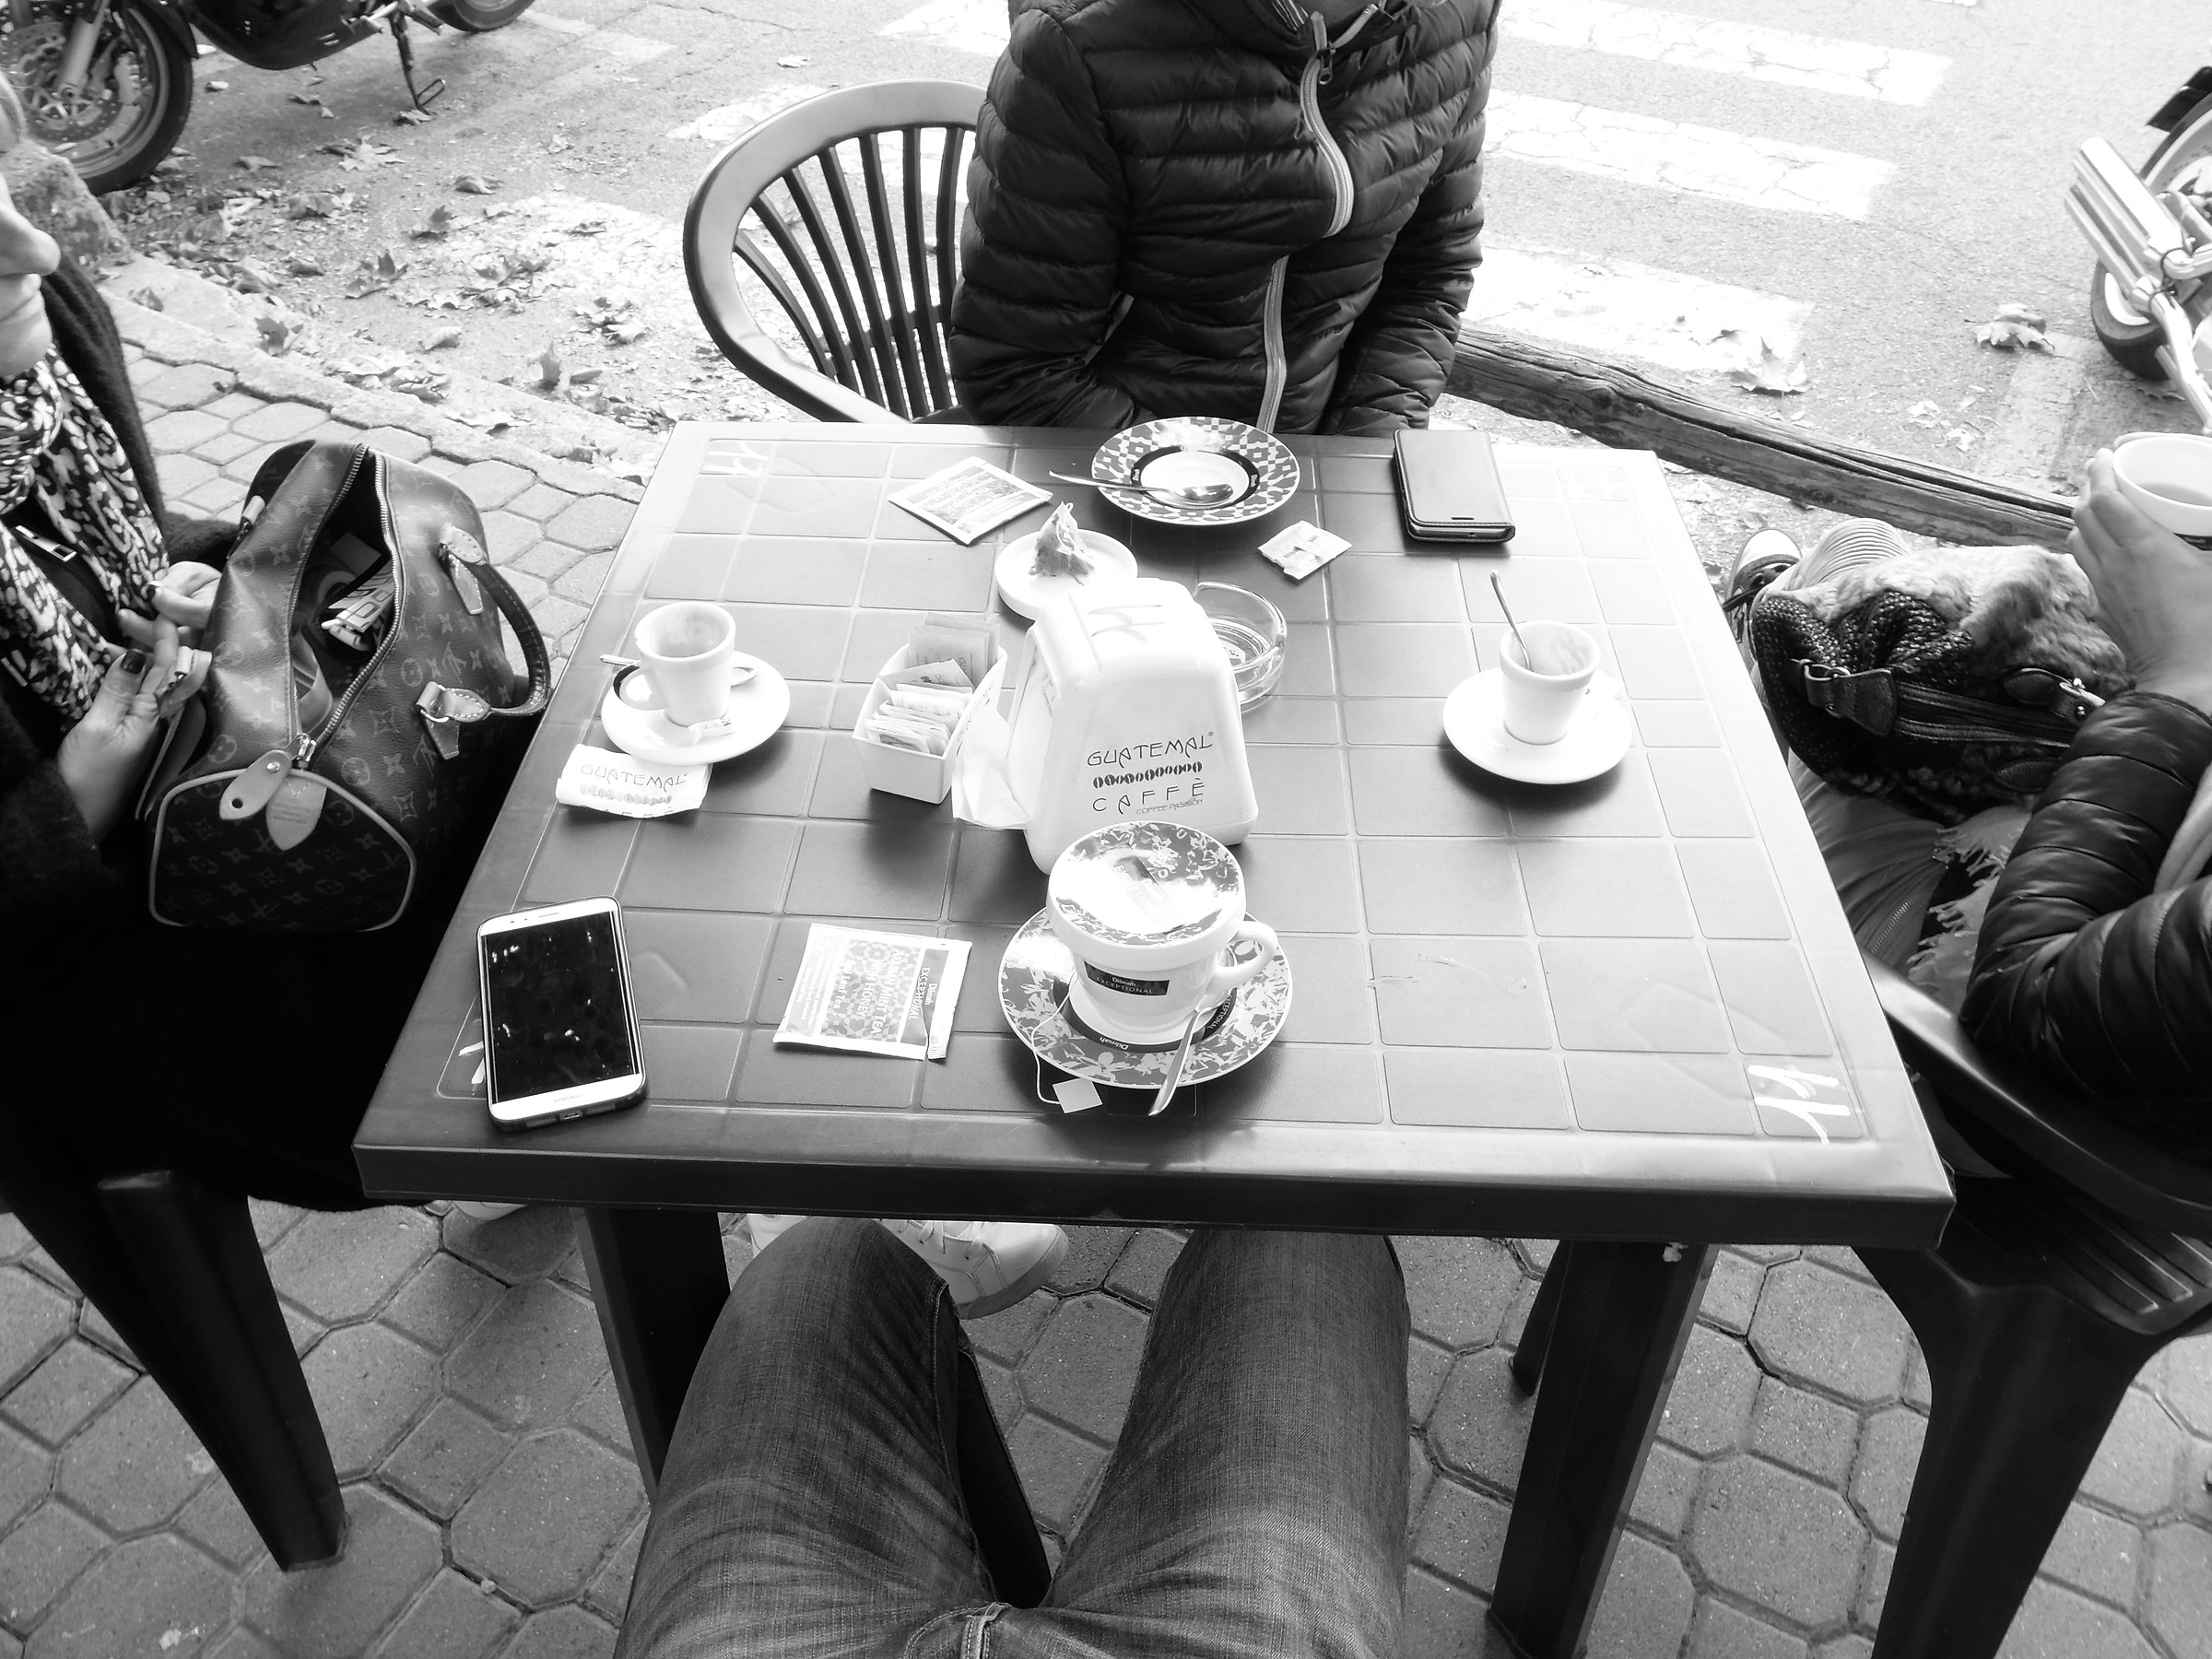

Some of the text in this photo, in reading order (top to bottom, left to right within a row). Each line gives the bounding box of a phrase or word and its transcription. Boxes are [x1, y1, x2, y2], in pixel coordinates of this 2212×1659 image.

[1112, 976, 1137, 987] Dilmah
[832, 994, 845, 1009] Tea
[857, 982, 877, 1018] HONEY
[877, 986, 895, 1012] MINT
[908, 967, 931, 1021] EXCEPTIONAL
[924, 982, 938, 1006] Dilmah
[870, 1013, 888, 1035] TEA
[1100, 1036, 1130, 1050] Dilmah
